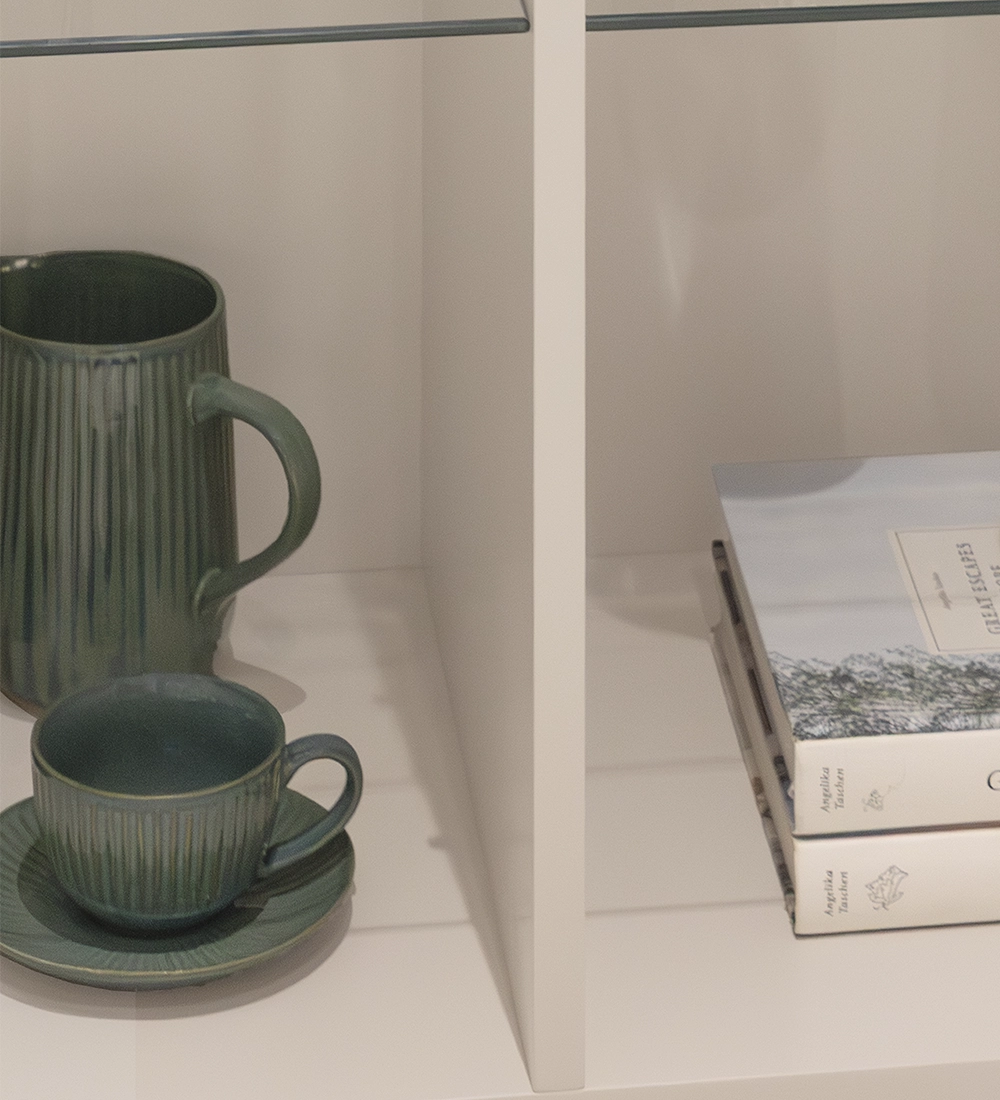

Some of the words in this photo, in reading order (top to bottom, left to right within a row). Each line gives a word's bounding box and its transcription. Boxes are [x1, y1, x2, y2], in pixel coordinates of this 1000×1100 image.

[956, 542, 988, 592] ESCAPES
[820, 766, 831, 813] Angelika
[835, 768, 845, 810] Taschen
[824, 869, 835, 917] Angelika
[839, 870, 849, 914] Taschen
